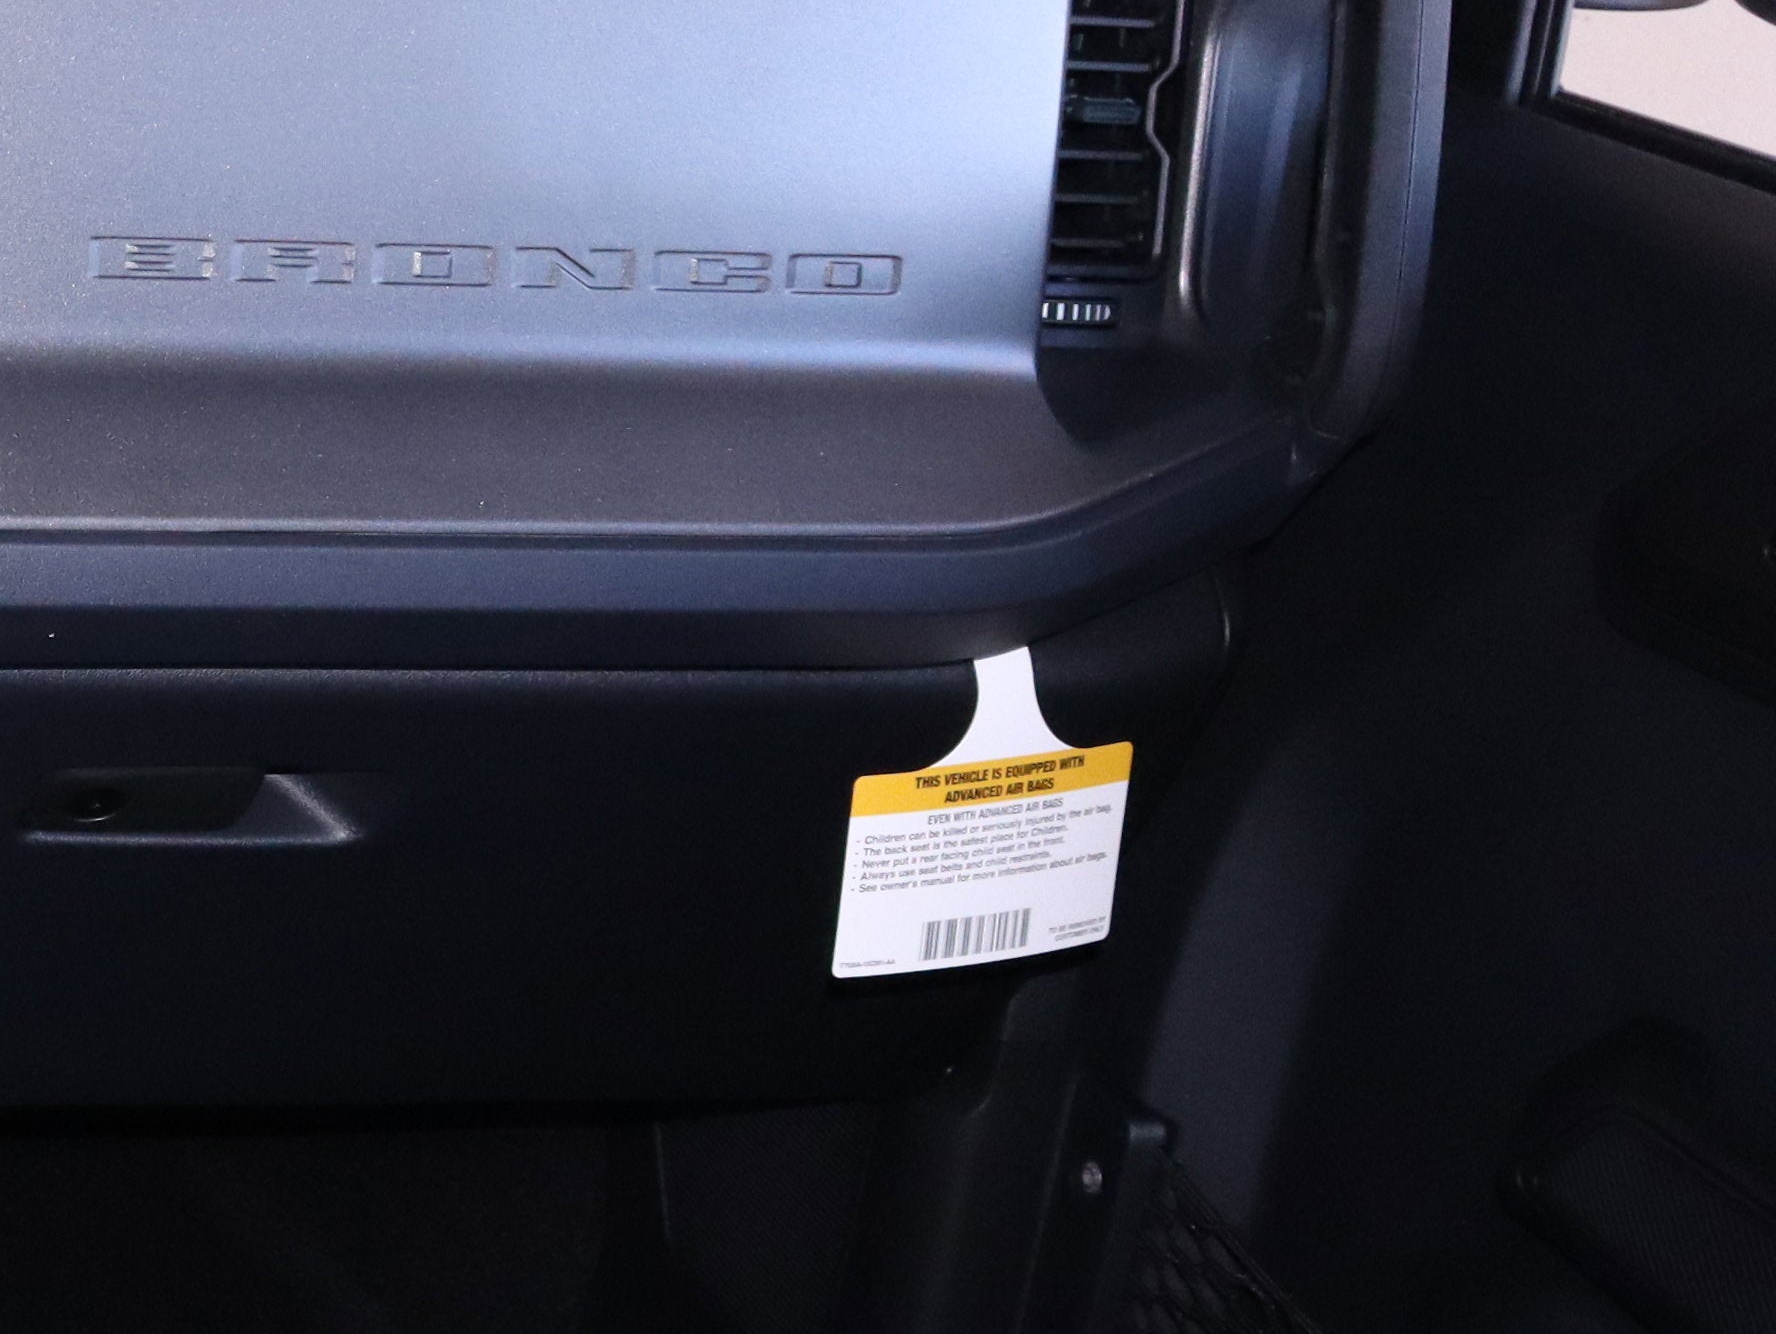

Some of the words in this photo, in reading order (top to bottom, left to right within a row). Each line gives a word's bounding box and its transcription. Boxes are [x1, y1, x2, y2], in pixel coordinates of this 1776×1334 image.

[89, 235, 903, 296] BRONCO
[915, 775, 941, 789] THIS
[944, 769, 989, 786] VEHICLE
[992, 768, 1002, 780] IS
[1005, 760, 1057, 778] EQUIPPED
[1059, 755, 1085, 770] WITH
[944, 785, 1003, 803] ADVANCED
[1006, 782, 1024, 796] AIR
[1027, 778, 1055, 793] BAGS
[928, 814, 950, 825] EVEN
[953, 810, 976, 822] WITH
[978, 803, 1024, 819] ADVANCED
[865, 834, 906, 845] Children
[909, 832, 925, 841] can
[929, 829, 940, 838] be
[970, 825, 980, 834] or
[1056, 811, 1066, 822] by
[864, 847, 881, 856] The
[884, 845, 907, 855] back
[861, 859, 890, 869] Never
[893, 856, 909, 867] put
[860, 871, 895, 882] Always
[859, 883, 878, 893] See
